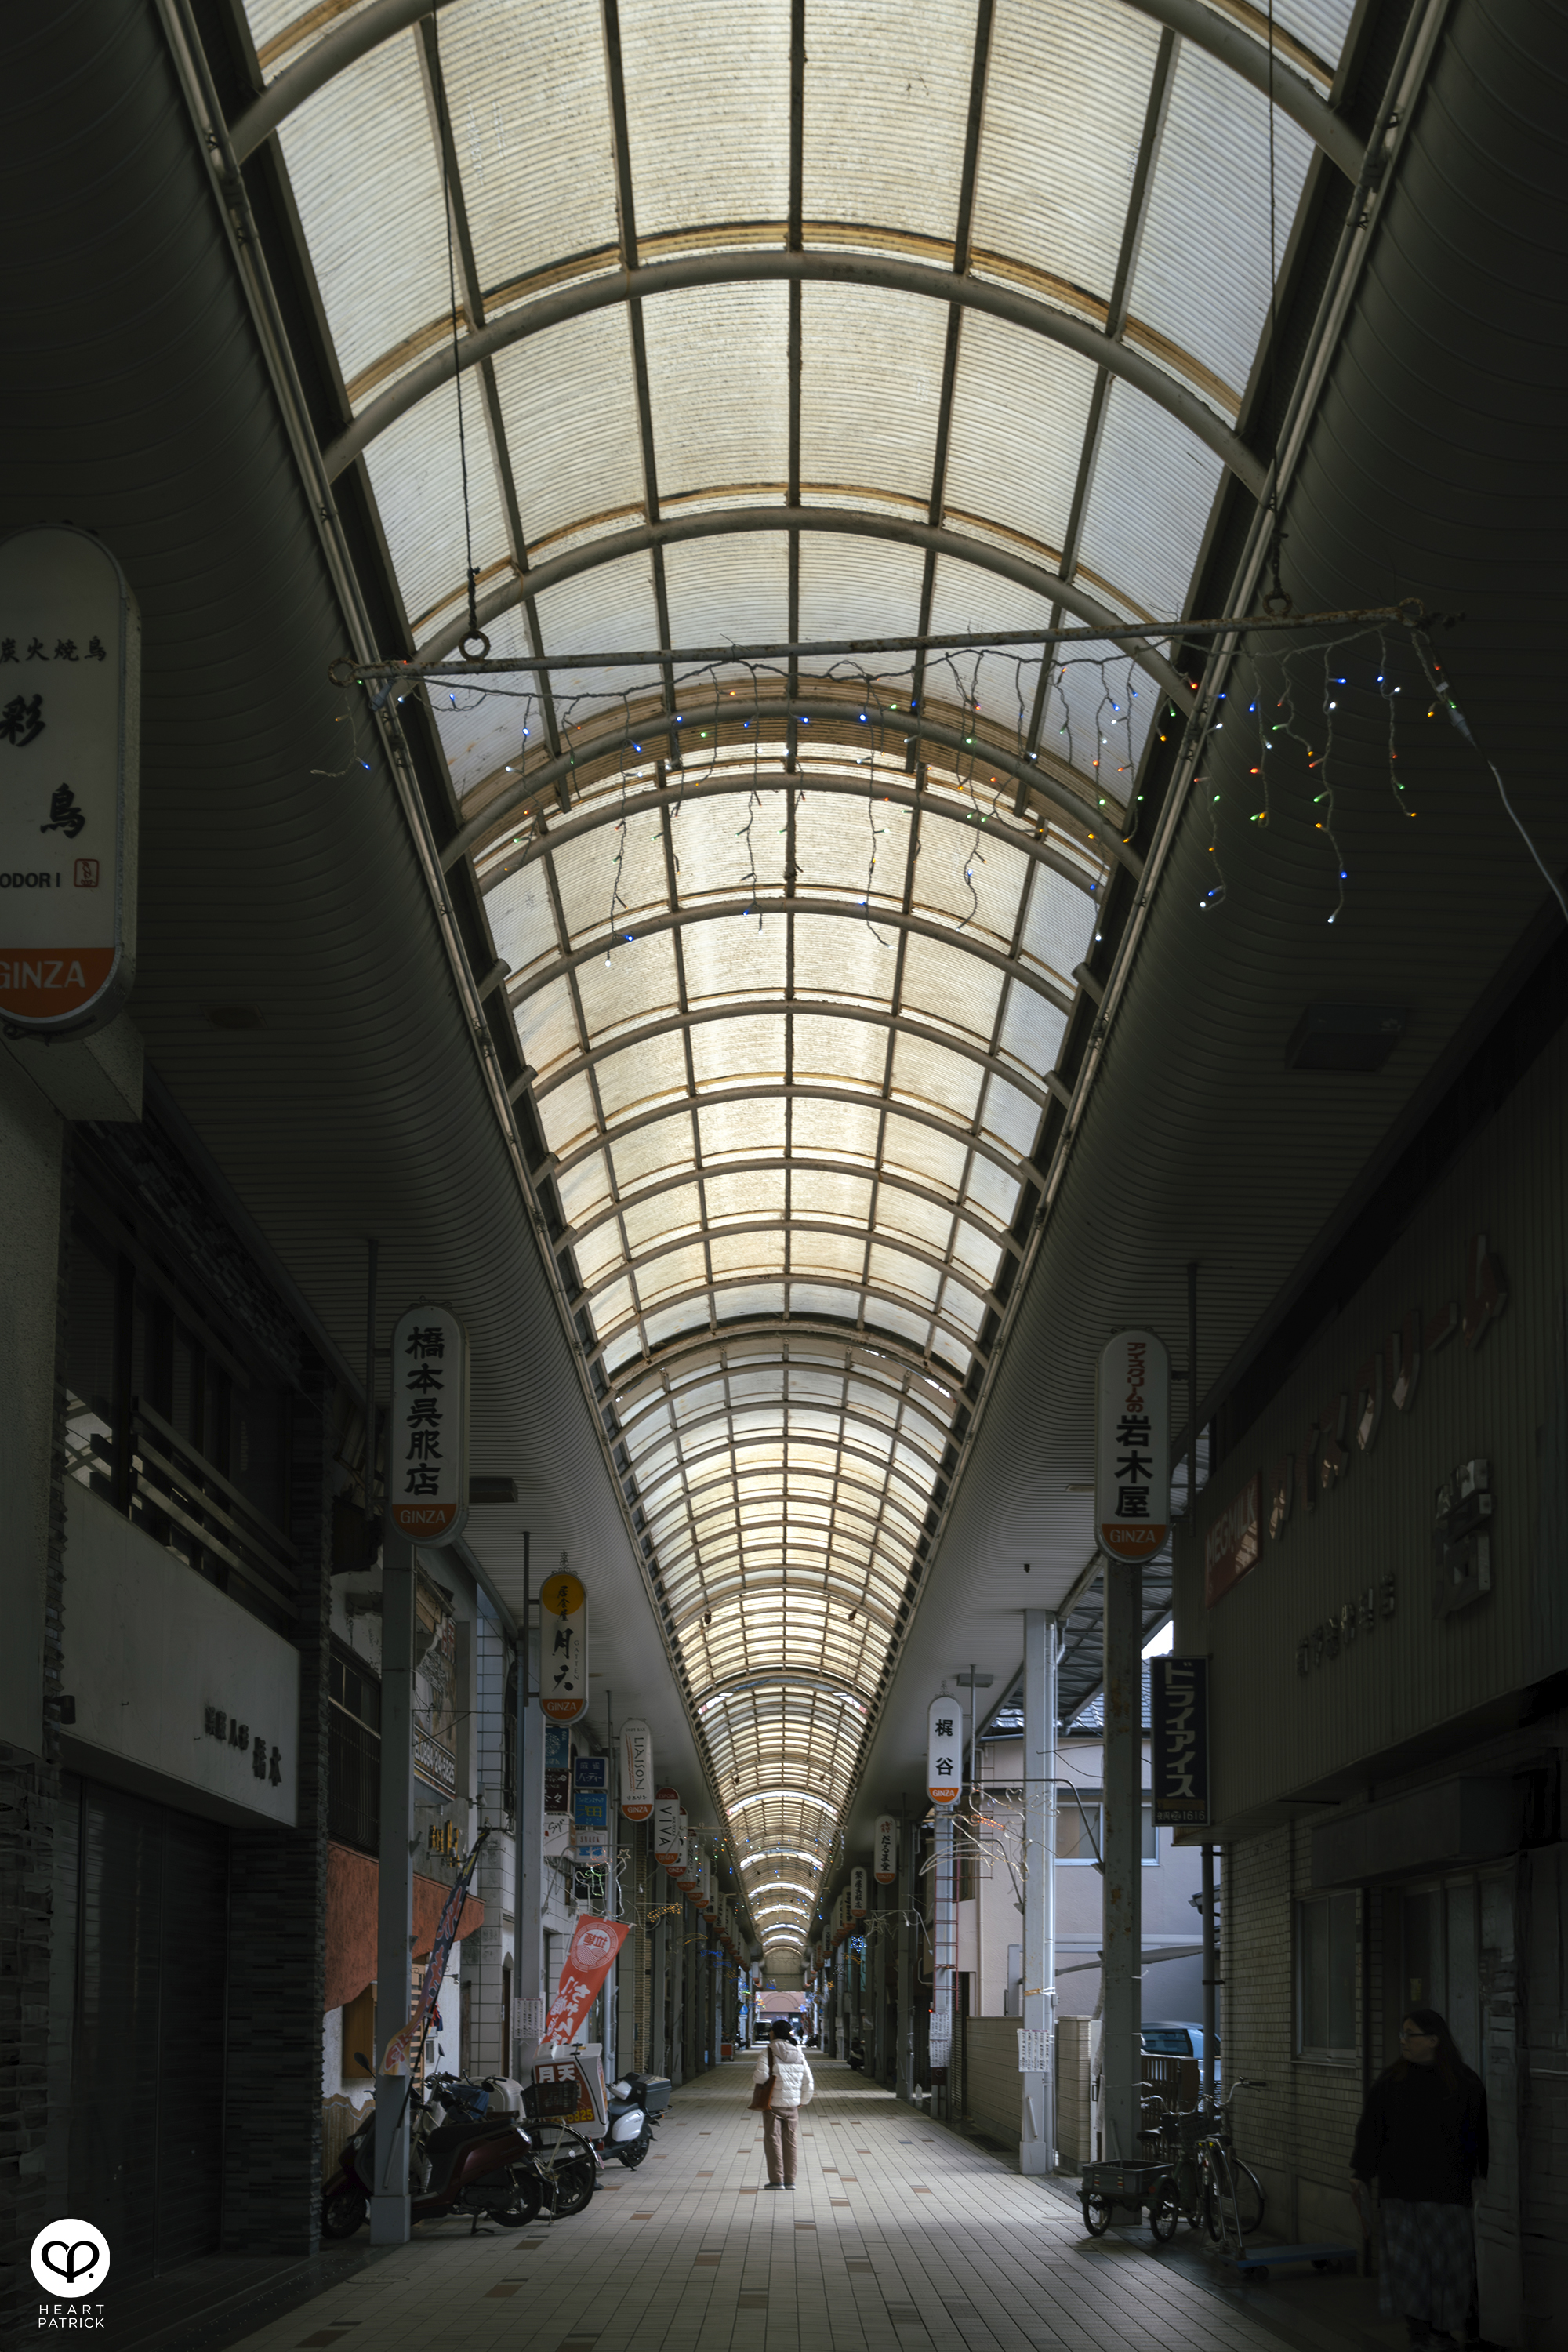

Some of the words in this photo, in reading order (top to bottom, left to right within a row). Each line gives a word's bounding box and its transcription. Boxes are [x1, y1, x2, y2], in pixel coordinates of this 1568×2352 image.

[0, 960, 85, 989] GINZA
[404, 1327, 445, 1495] 橋本呉服店
[1114, 1414, 1153, 1518] 岩木屋
[400, 1510, 446, 1523] GINZA
[1109, 1530, 1156, 1543] GINZA
[1206, 1483, 1256, 1570] MEGMILK
[547, 1702, 577, 1711] GINZA
[935, 1719, 953, 1776] 梶谷
[1164, 1661, 1196, 1798] ドライアイス
[580, 1762, 601, 1770] 麻雀
[634, 1737, 645, 1790] LIAISON
[659, 1806, 672, 1846] VIVA
[538, 2063, 576, 2084] 月天
